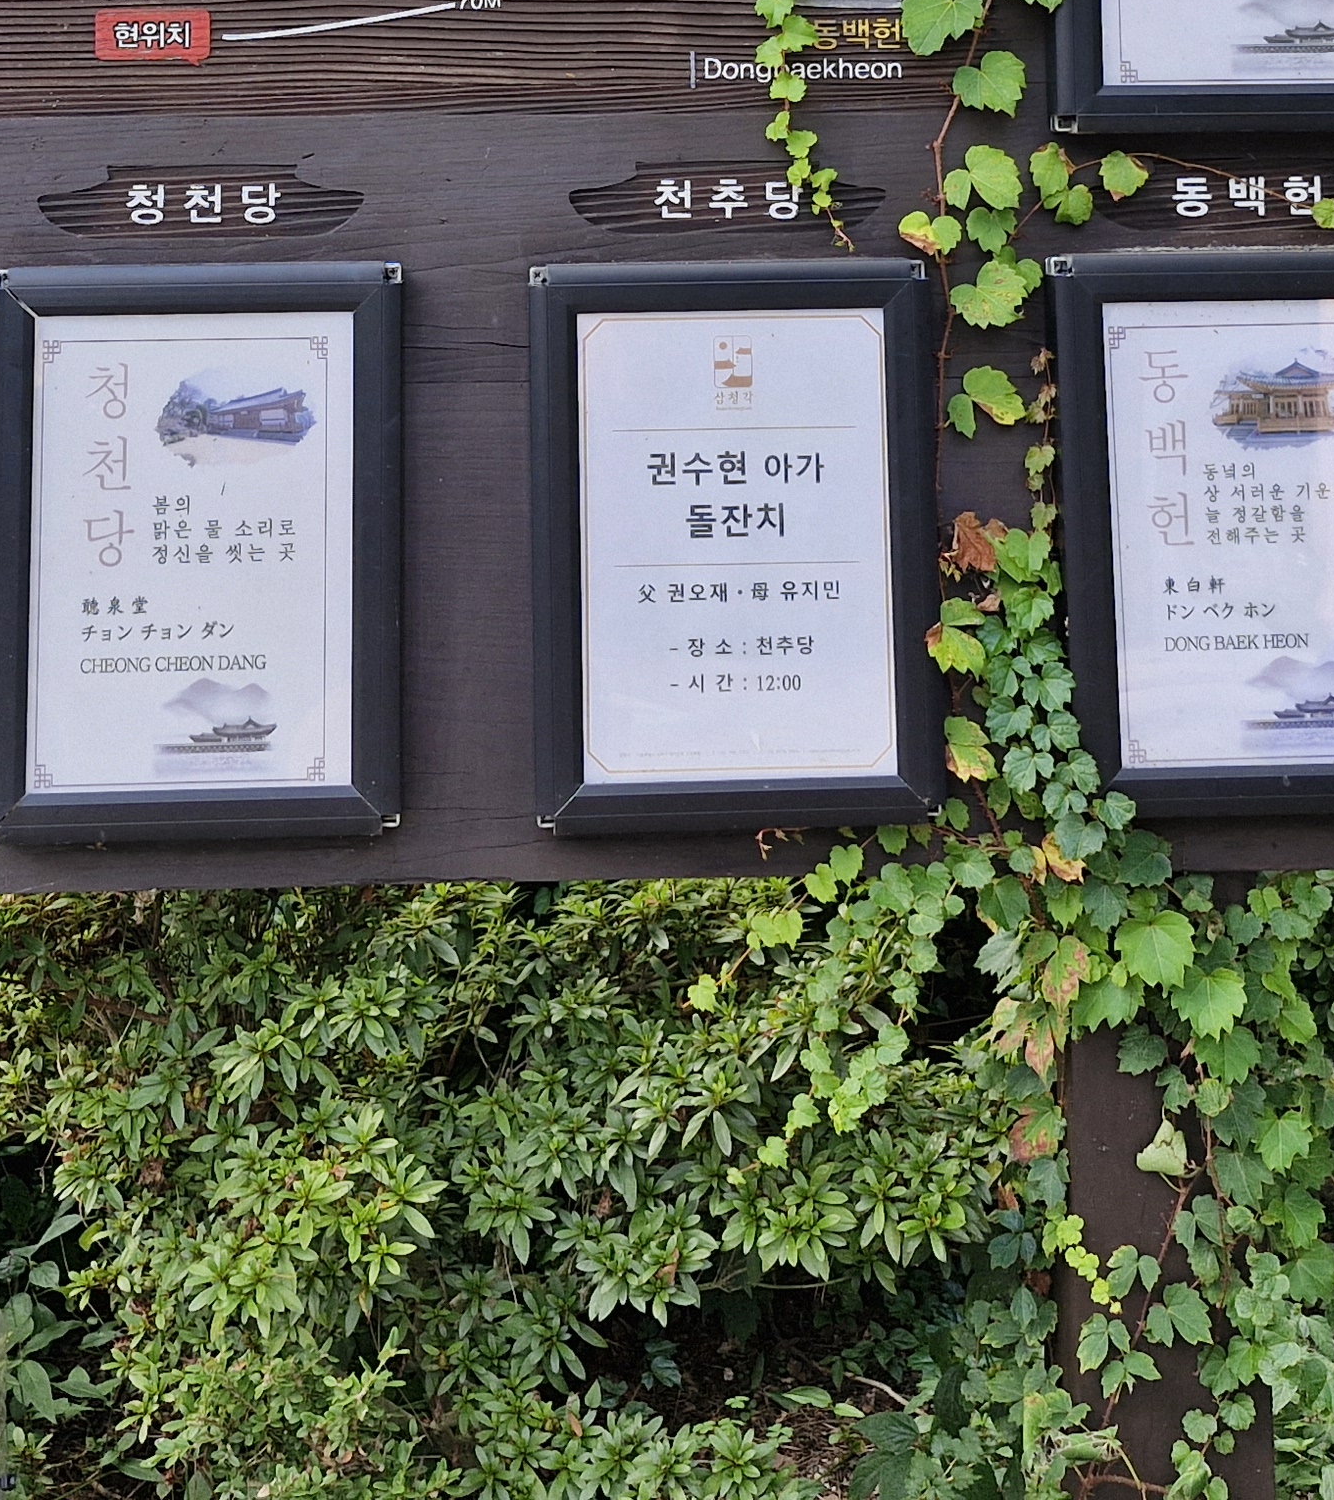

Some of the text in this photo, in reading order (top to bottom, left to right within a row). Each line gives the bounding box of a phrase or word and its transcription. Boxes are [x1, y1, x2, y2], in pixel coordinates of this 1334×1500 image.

[113, 21, 191, 50] 현위치
[813, 17, 902, 50] 동백헌
[127, 183, 280, 224] 청천당
[655, 176, 807, 219] 천추당
[1171, 174, 1322, 218] 동백헌
[713, 390, 754, 405] 삼청각
[1137, 349, 1197, 547] 동백헌
[82, 361, 135, 568] 청천당
[647, 451, 824, 486] 권수현 아가
[1204, 485, 1219, 503] 상
[153, 495, 190, 515] 봄의
[1206, 504, 1305, 523] 늘 정갈함을
[153, 518, 295, 540] 맑은 물 소리로
[686, 503, 784, 538] 돌잔치
[1207, 526, 1305, 545] 전해주는 곳
[153, 543, 295, 564] 정신을 씻는 곳
[639, 585, 655, 603] 父
[668, 583, 727, 602] 권오재
[751, 582, 768, 601] 母
[781, 581, 839, 601] 유지민
[1164, 576, 1224, 594] 東白軒
[757, 636, 814, 655] 천추당
[1165, 633, 1308, 651] DONG BAEK HEON
[80, 654, 266, 674] CHEONG CHEON DANG
[758, 675, 801, 691] 12:00
